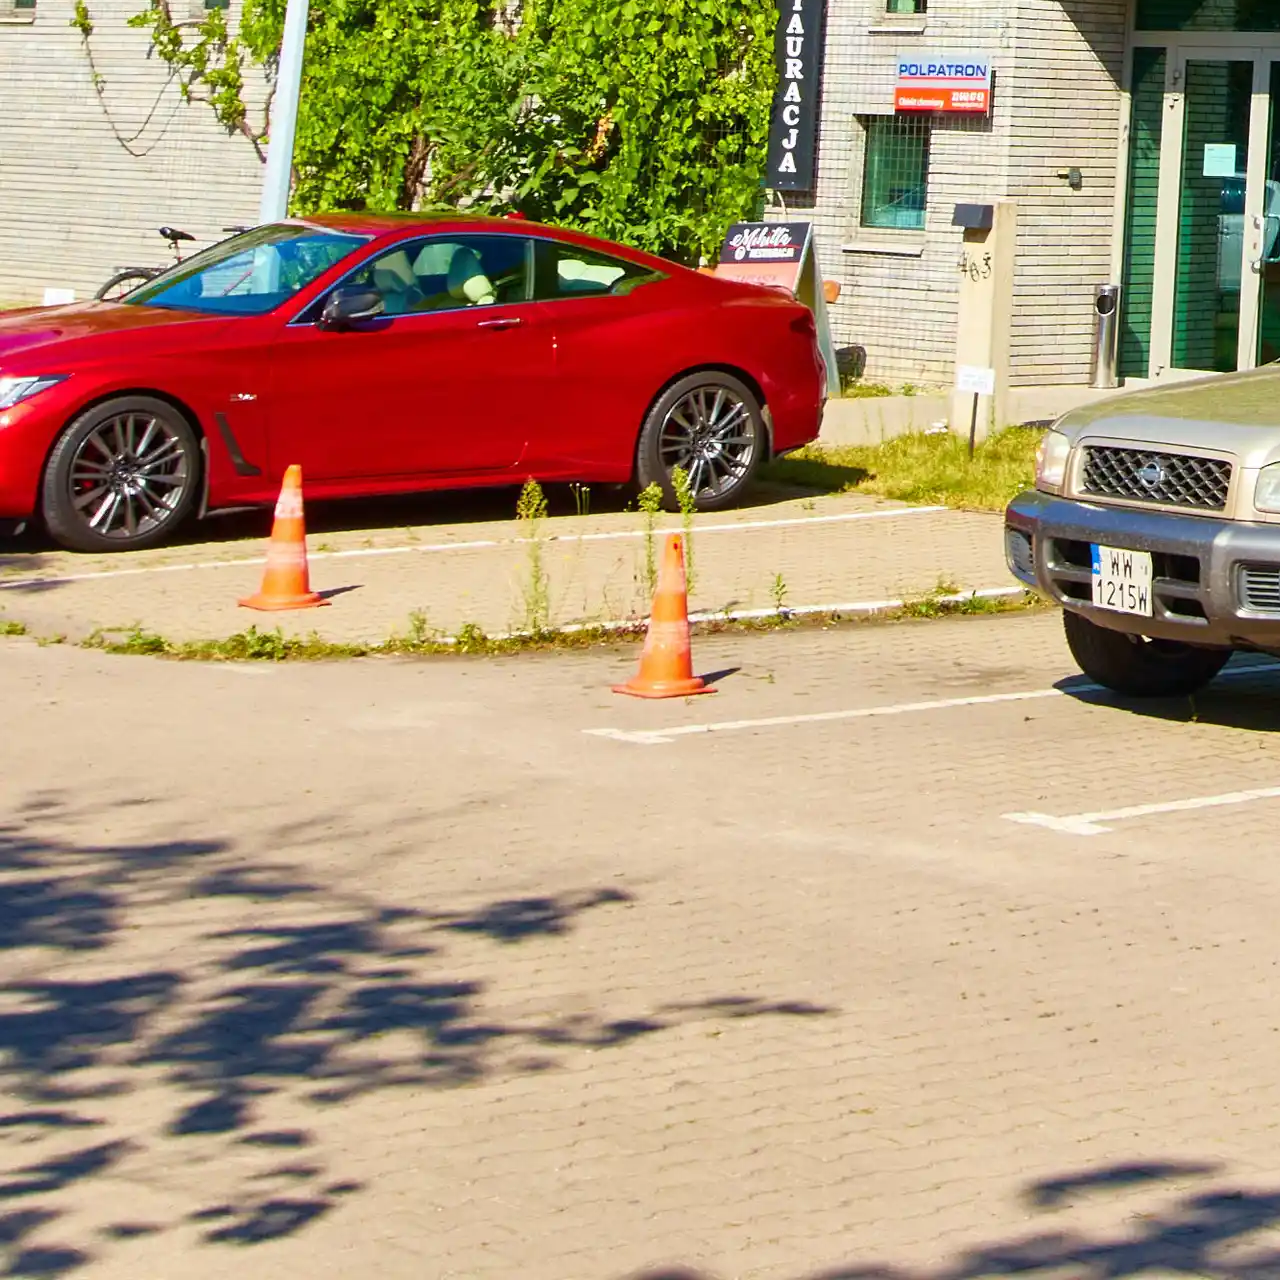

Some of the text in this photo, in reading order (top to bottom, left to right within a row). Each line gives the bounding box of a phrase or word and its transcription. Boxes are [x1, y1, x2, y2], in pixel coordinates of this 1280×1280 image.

[899, 64, 987, 76] POLPATRON
[957, 252, 992, 282] 465
[1110, 550, 1133, 578] WW
[1097, 579, 1148, 612] 1215W
